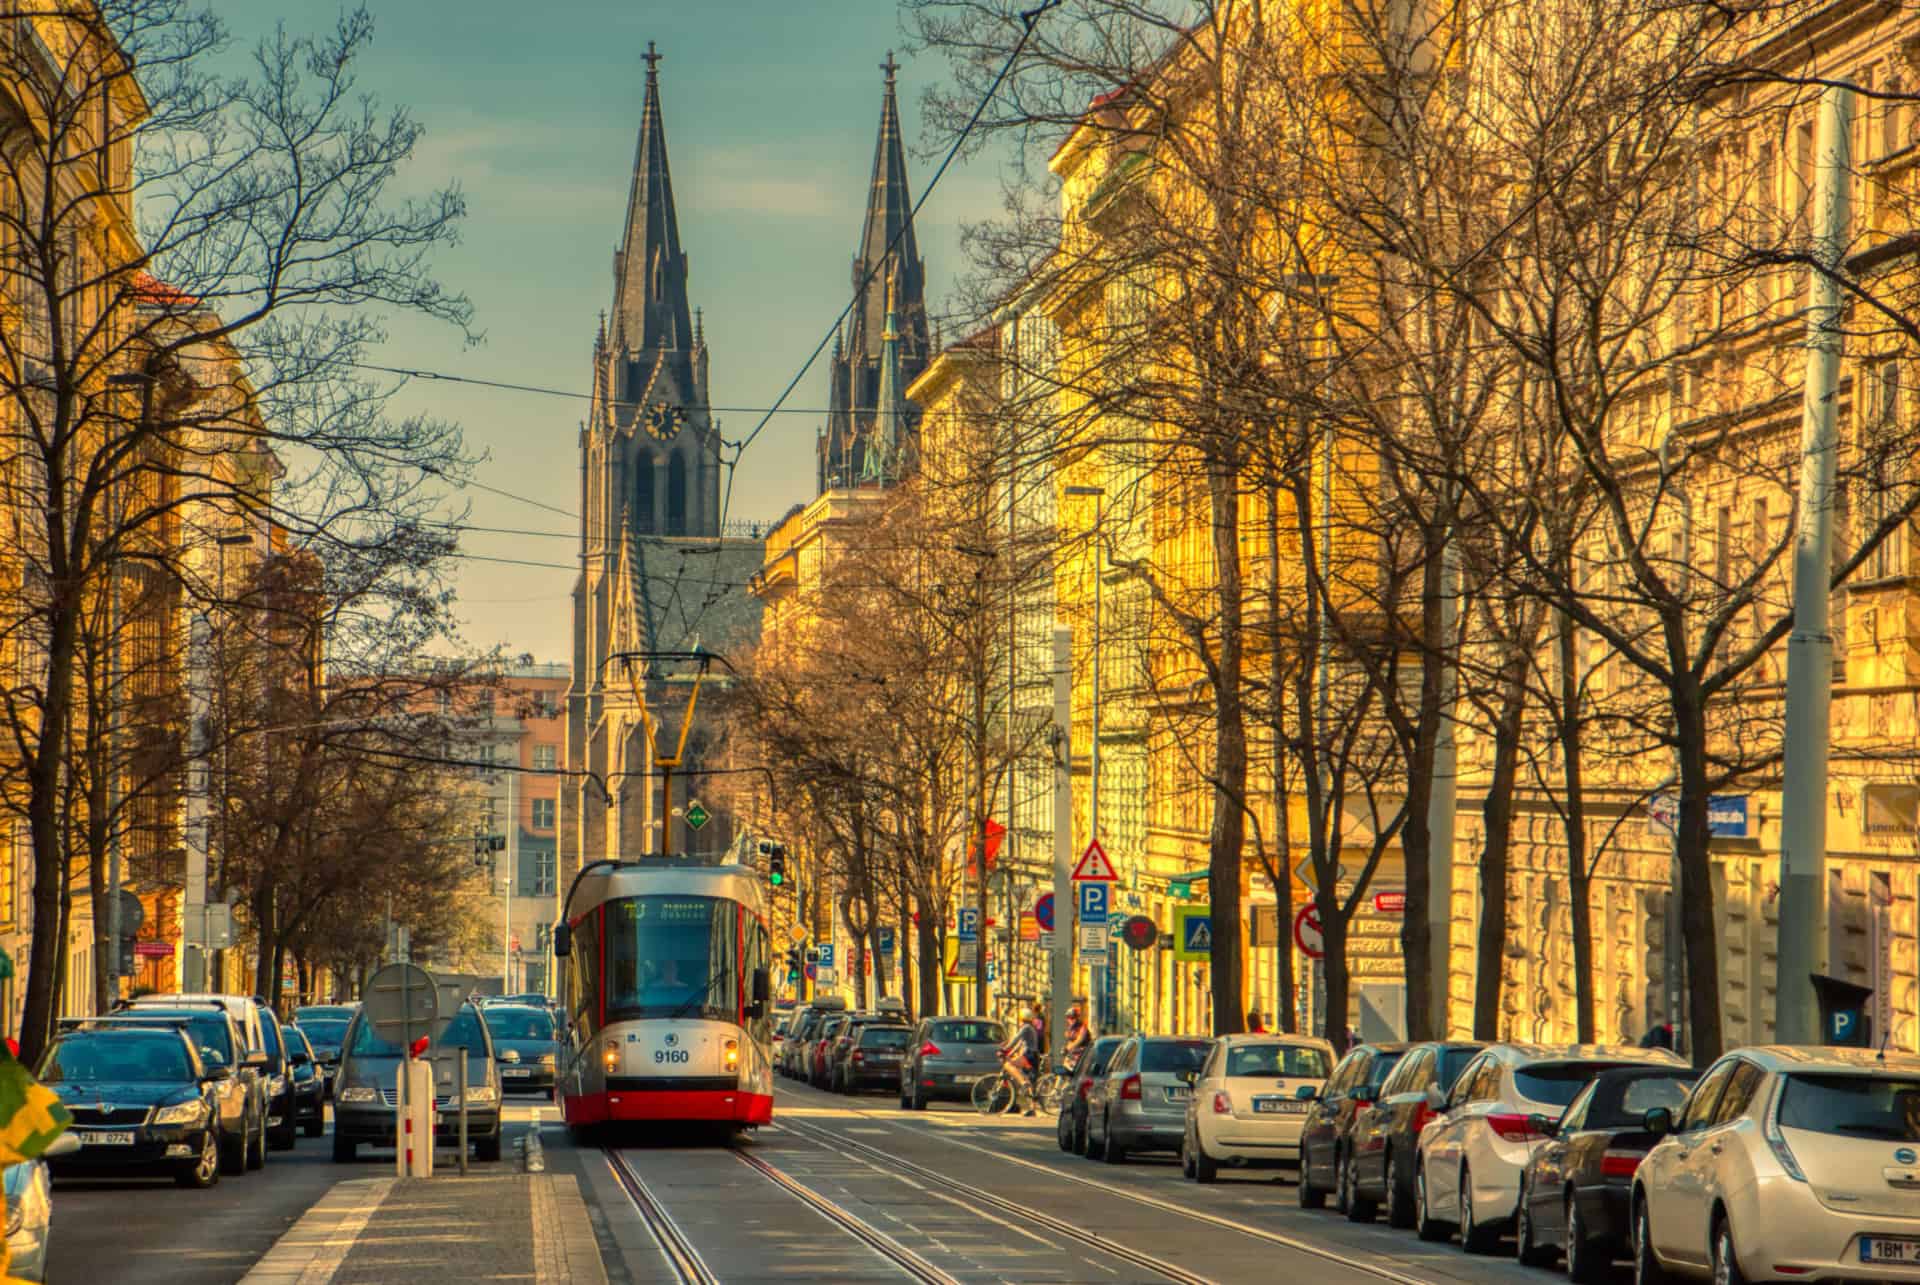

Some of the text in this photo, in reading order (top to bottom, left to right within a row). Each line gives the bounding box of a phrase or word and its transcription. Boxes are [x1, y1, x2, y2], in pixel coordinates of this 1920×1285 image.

[1085, 886, 1103, 912] P
[963, 911, 977, 932] P
[821, 946, 832, 961] P
[1834, 1012, 1849, 1035] P
[655, 1050, 689, 1063] 9160
[1875, 1241, 1904, 1258] 1BM
